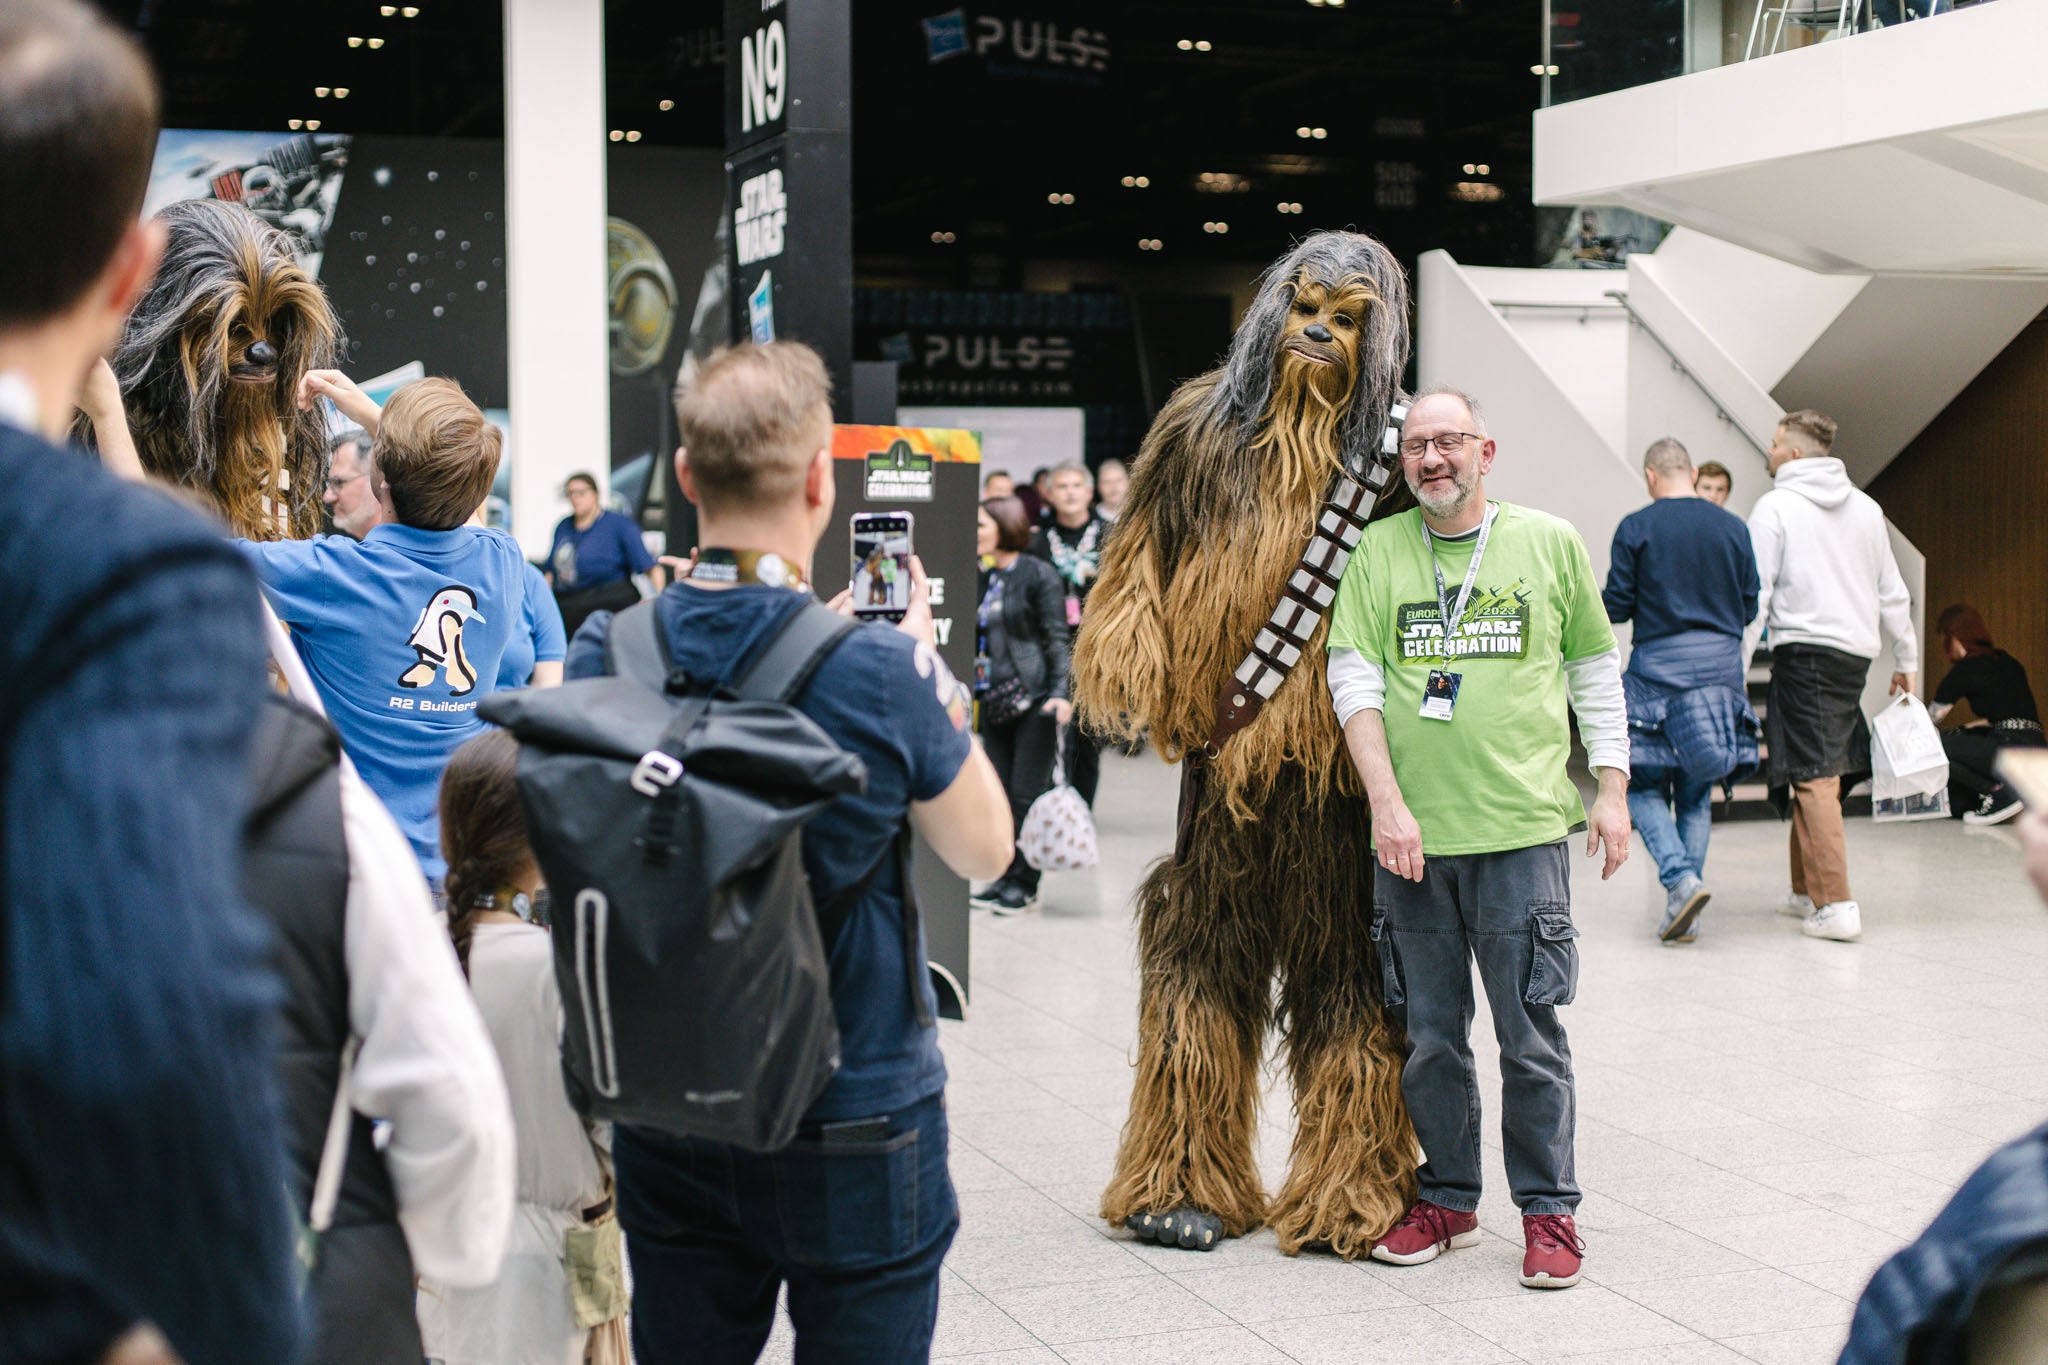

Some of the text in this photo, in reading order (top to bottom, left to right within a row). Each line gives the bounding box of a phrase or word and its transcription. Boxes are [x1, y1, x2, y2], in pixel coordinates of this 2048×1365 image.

[975, 15, 1111, 71] PULSE
[741, 19, 786, 133] N9
[923, 334, 1075, 370] PULSE
[1483, 607, 1516, 616] 2023
[1462, 620, 1522, 636] WARS
[1403, 636, 1522, 657] CELEBRATION
[389, 696, 478, 712] R2 Builders
